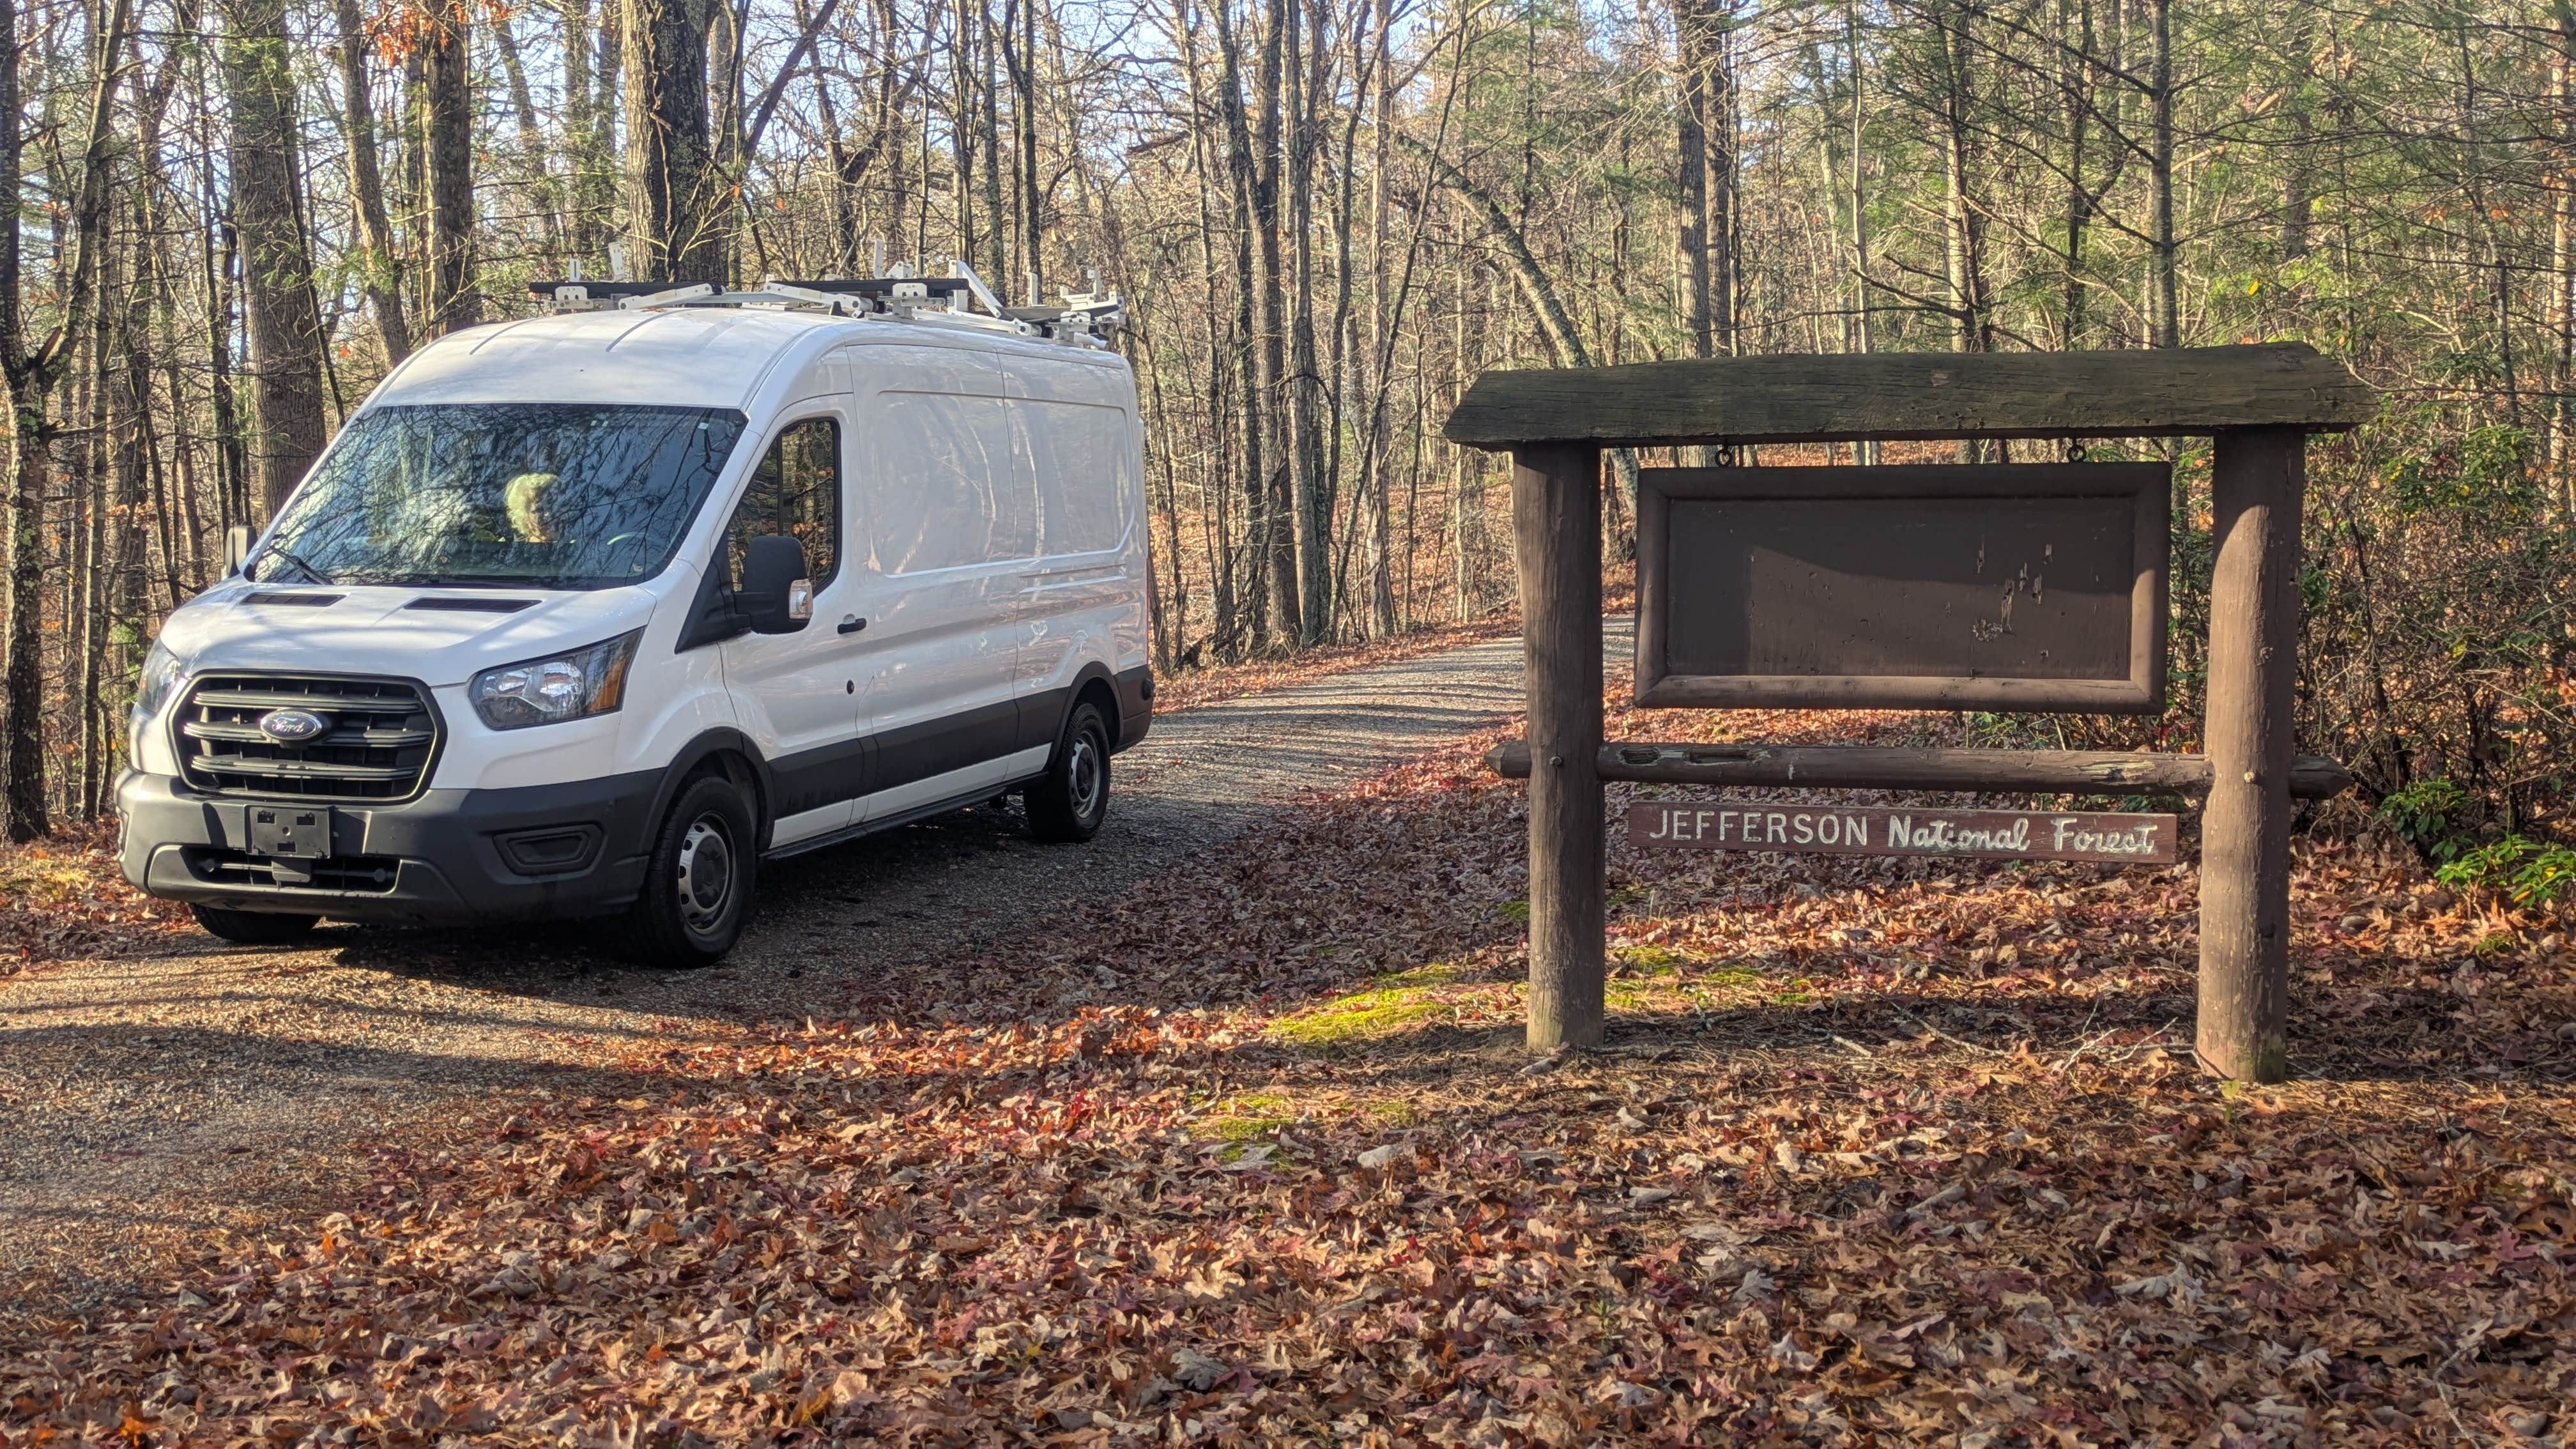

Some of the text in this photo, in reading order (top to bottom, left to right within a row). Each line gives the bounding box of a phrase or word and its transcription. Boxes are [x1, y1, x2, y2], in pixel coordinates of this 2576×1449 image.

[272, 717, 305, 732] Ford
[1649, 809, 2158, 854] JEFFERSON National Forest
